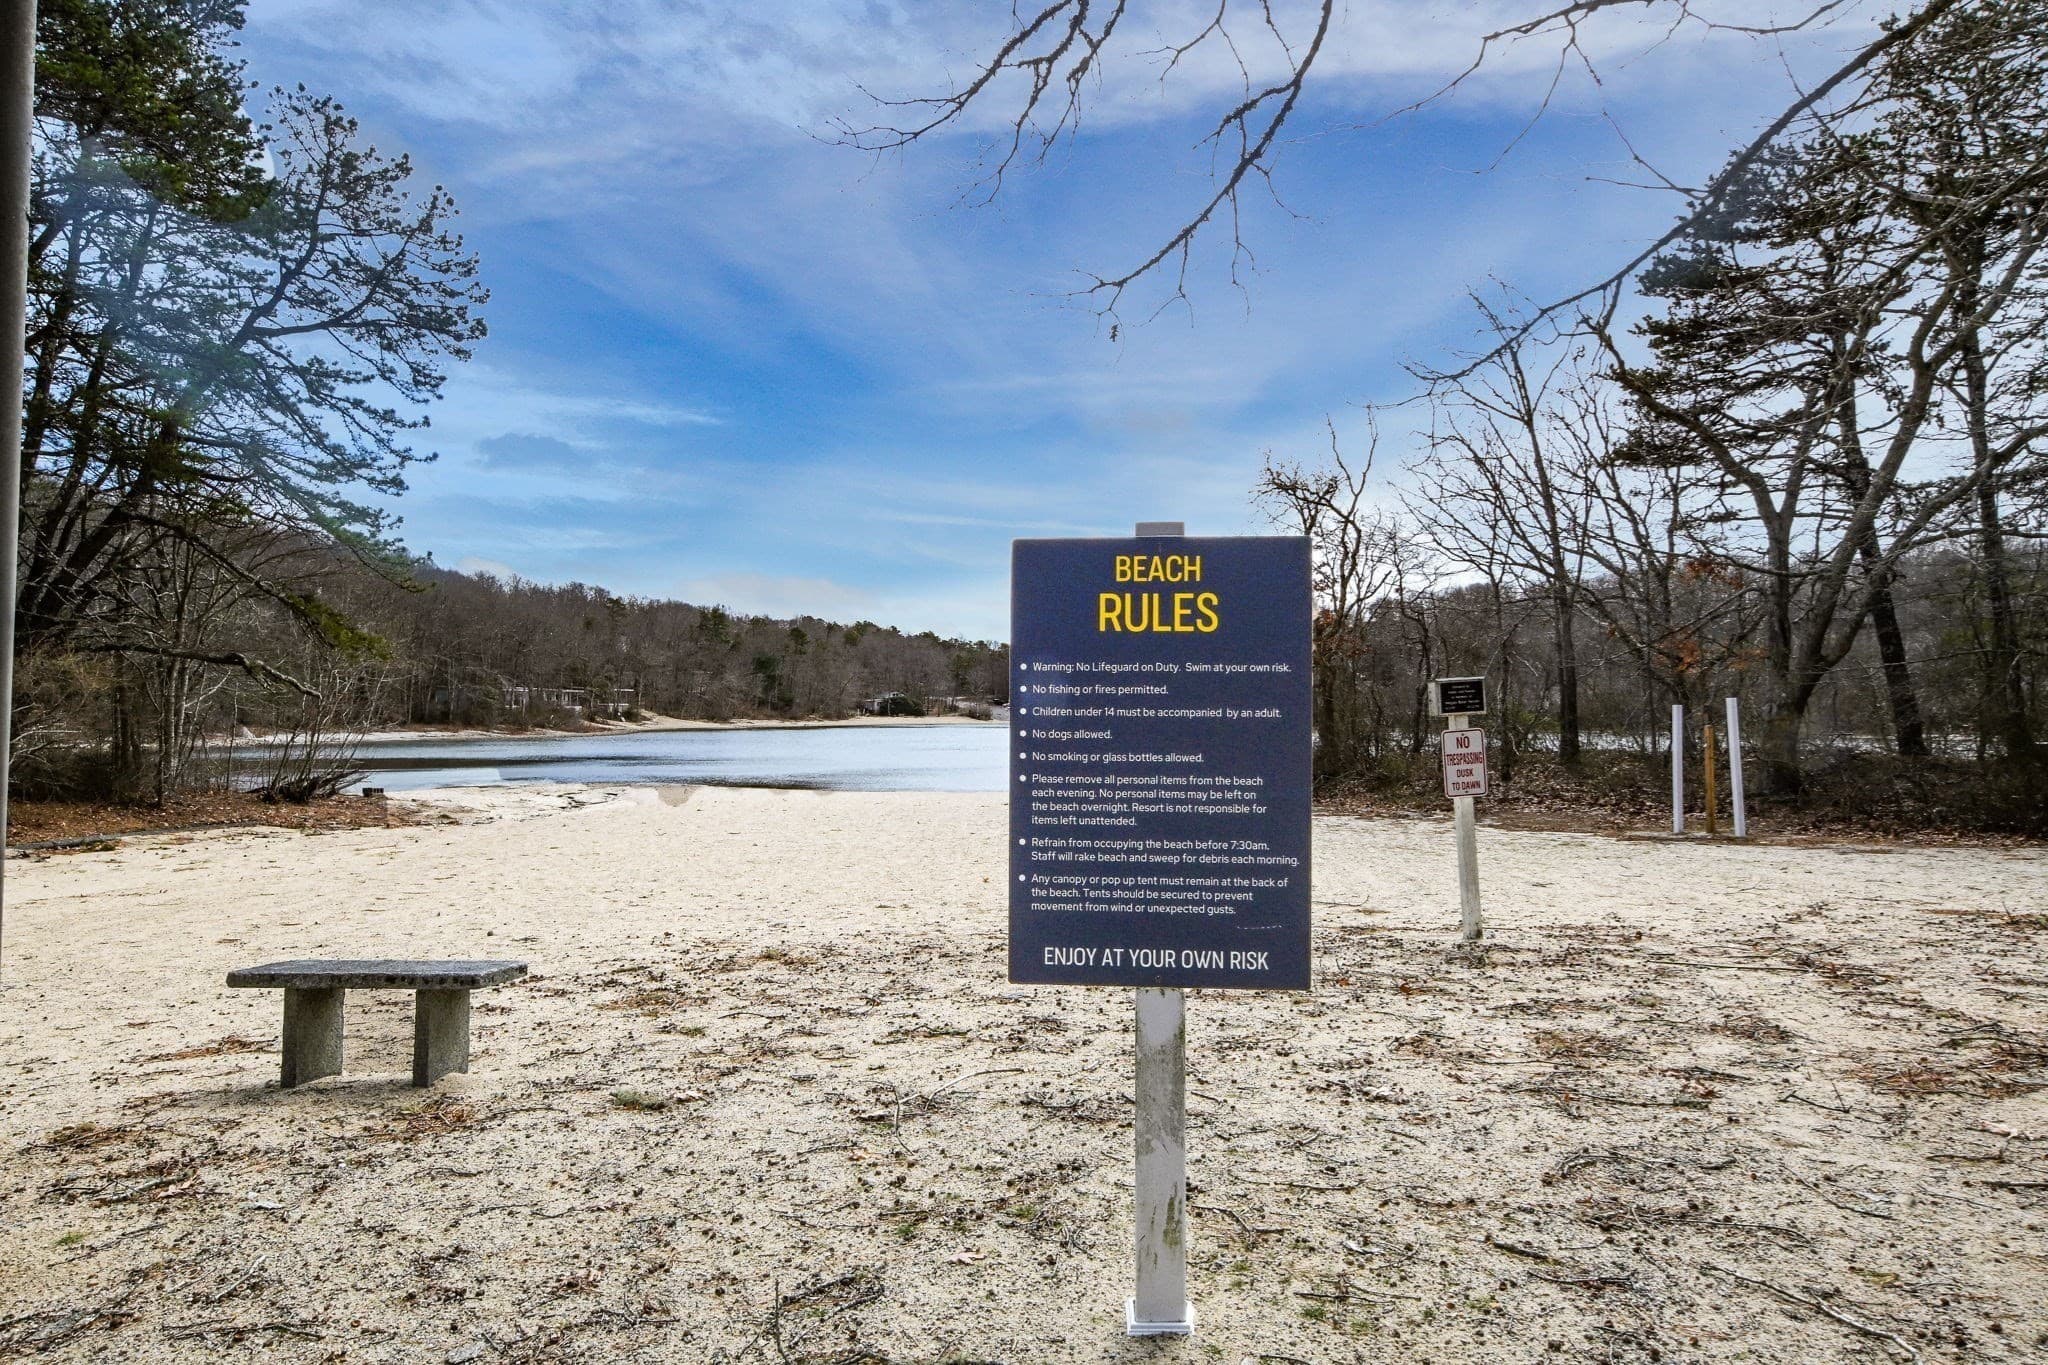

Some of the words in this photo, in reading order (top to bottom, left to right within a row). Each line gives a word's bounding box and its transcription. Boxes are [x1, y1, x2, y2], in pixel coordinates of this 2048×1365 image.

[1116, 555, 1200, 582] BEACH
[1100, 592, 1218, 632] RULES
[1032, 662, 1074, 673] Warning:
[1076, 662, 1090, 671] No
[1092, 662, 1138, 673] Lifeguard
[1156, 662, 1180, 673] Duty.
[1186, 662, 1211, 671] Swim
[1213, 663, 1223, 671] at
[1225, 665, 1247, 674] your
[1272, 663, 1291, 672] risk.
[1032, 685, 1046, 693] No
[1048, 684, 1080, 695] fishing
[1095, 684, 1116, 693] fires
[1118, 685, 1168, 695] permitted.
[1032, 706, 1072, 716] Children
[1074, 707, 1102, 716] under
[1104, 707, 1114, 716] 14
[1117, 708, 1141, 716] must
[1143, 707, 1155, 716] be
[1157, 708, 1222, 719] accompanied
[1226, 708, 1239, 719] by
[1254, 708, 1282, 717] adult.
[1032, 729, 1046, 738] No
[1048, 729, 1072, 740] dogs
[1074, 729, 1112, 738] allowed.
[1456, 736, 1470, 749] NO
[1032, 752, 1046, 760] No
[1048, 752, 1088, 763] smoking
[1102, 752, 1126, 763] glass
[1128, 752, 1163, 762] bottles
[1165, 753, 1204, 762] allowed.
[1446, 752, 1484, 767] TRESPASSING
[1457, 768, 1474, 778] DUSK
[1032, 774, 1063, 783] Please
[1066, 776, 1102, 784] remove
[1104, 775, 1114, 784] all
[1117, 775, 1158, 786] personal
[1160, 776, 1187, 784] items
[1189, 775, 1212, 785] from
[1215, 776, 1231, 785] the
[1233, 776, 1263, 785] beach
[1452, 782, 1461, 791] TO
[1462, 781, 1481, 790] DAWN
[1032, 788, 1054, 797] each
[1056, 788, 1096, 799] evening.
[1099, 788, 1113, 798] No
[1115, 789, 1156, 800] personal
[1158, 789, 1186, 798] items
[1187, 791, 1208, 801] may
[1210, 790, 1222, 799] be
[1224, 789, 1242, 799] left
[1032, 801, 1048, 810] the
[1050, 802, 1079, 811] beach
[1081, 802, 1129, 814] overnight.
[1132, 802, 1164, 812] Resort
[1166, 803, 1174, 812] is
[1176, 804, 1192, 812] not
[1194, 804, 1250, 814] responsible
[1252, 804, 1267, 813] for
[1032, 815, 1058, 824] items
[1060, 815, 1076, 824] left
[1079, 816, 1136, 825] unattended.
[1032, 837, 1066, 847] Refrain
[1068, 837, 1091, 847] from
[1094, 839, 1143, 850] occupying
[1145, 839, 1161, 848] the
[1164, 840, 1193, 849] beach
[1195, 840, 1228, 849] before
[1230, 840, 1269, 850] 7:30am.
[1032, 851, 1056, 860] Staff
[1058, 852, 1072, 860] will
[1074, 852, 1096, 861] rake
[1098, 852, 1126, 861] beach
[1129, 853, 1147, 862] and
[1149, 855, 1180, 864] sweep
[1182, 853, 1196, 862] for
[1198, 854, 1229, 863] debris
[1231, 855, 1254, 863] each
[1256, 855, 1299, 866] morning.
[1031, 874, 1050, 885] Any
[1052, 876, 1087, 886] canopy
[1102, 877, 1120, 886] pop
[1122, 877, 1135, 886] up
[1137, 876, 1157, 885] tent
[1160, 877, 1184, 885] must
[1186, 877, 1219, 885] remain
[1221, 878, 1231, 886] at
[1234, 877, 1250, 886] the
[1252, 878, 1275, 887] back
[1277, 877, 1288, 887] of
[1031, 887, 1047, 896] the
[1049, 887, 1080, 897] beach.
[1082, 888, 1110, 897] Tents
[1112, 889, 1144, 898] should
[1146, 889, 1158, 898] be
[1160, 890, 1200, 899] secured
[1202, 892, 1212, 900] to
[1214, 892, 1253, 902] prevent
[1031, 903, 1082, 911] movement
[1085, 901, 1108, 911] from
[1110, 902, 1132, 912] wind
[1148, 904, 1205, 915] unexpected
[1207, 906, 1236, 916] gusts.
[1044, 947, 1096, 966] ENJOY
[1102, 948, 1124, 966] AT
[1129, 949, 1176, 967] YOUR
[1182, 950, 1223, 968] OWN
[1230, 951, 1268, 970] RISK
